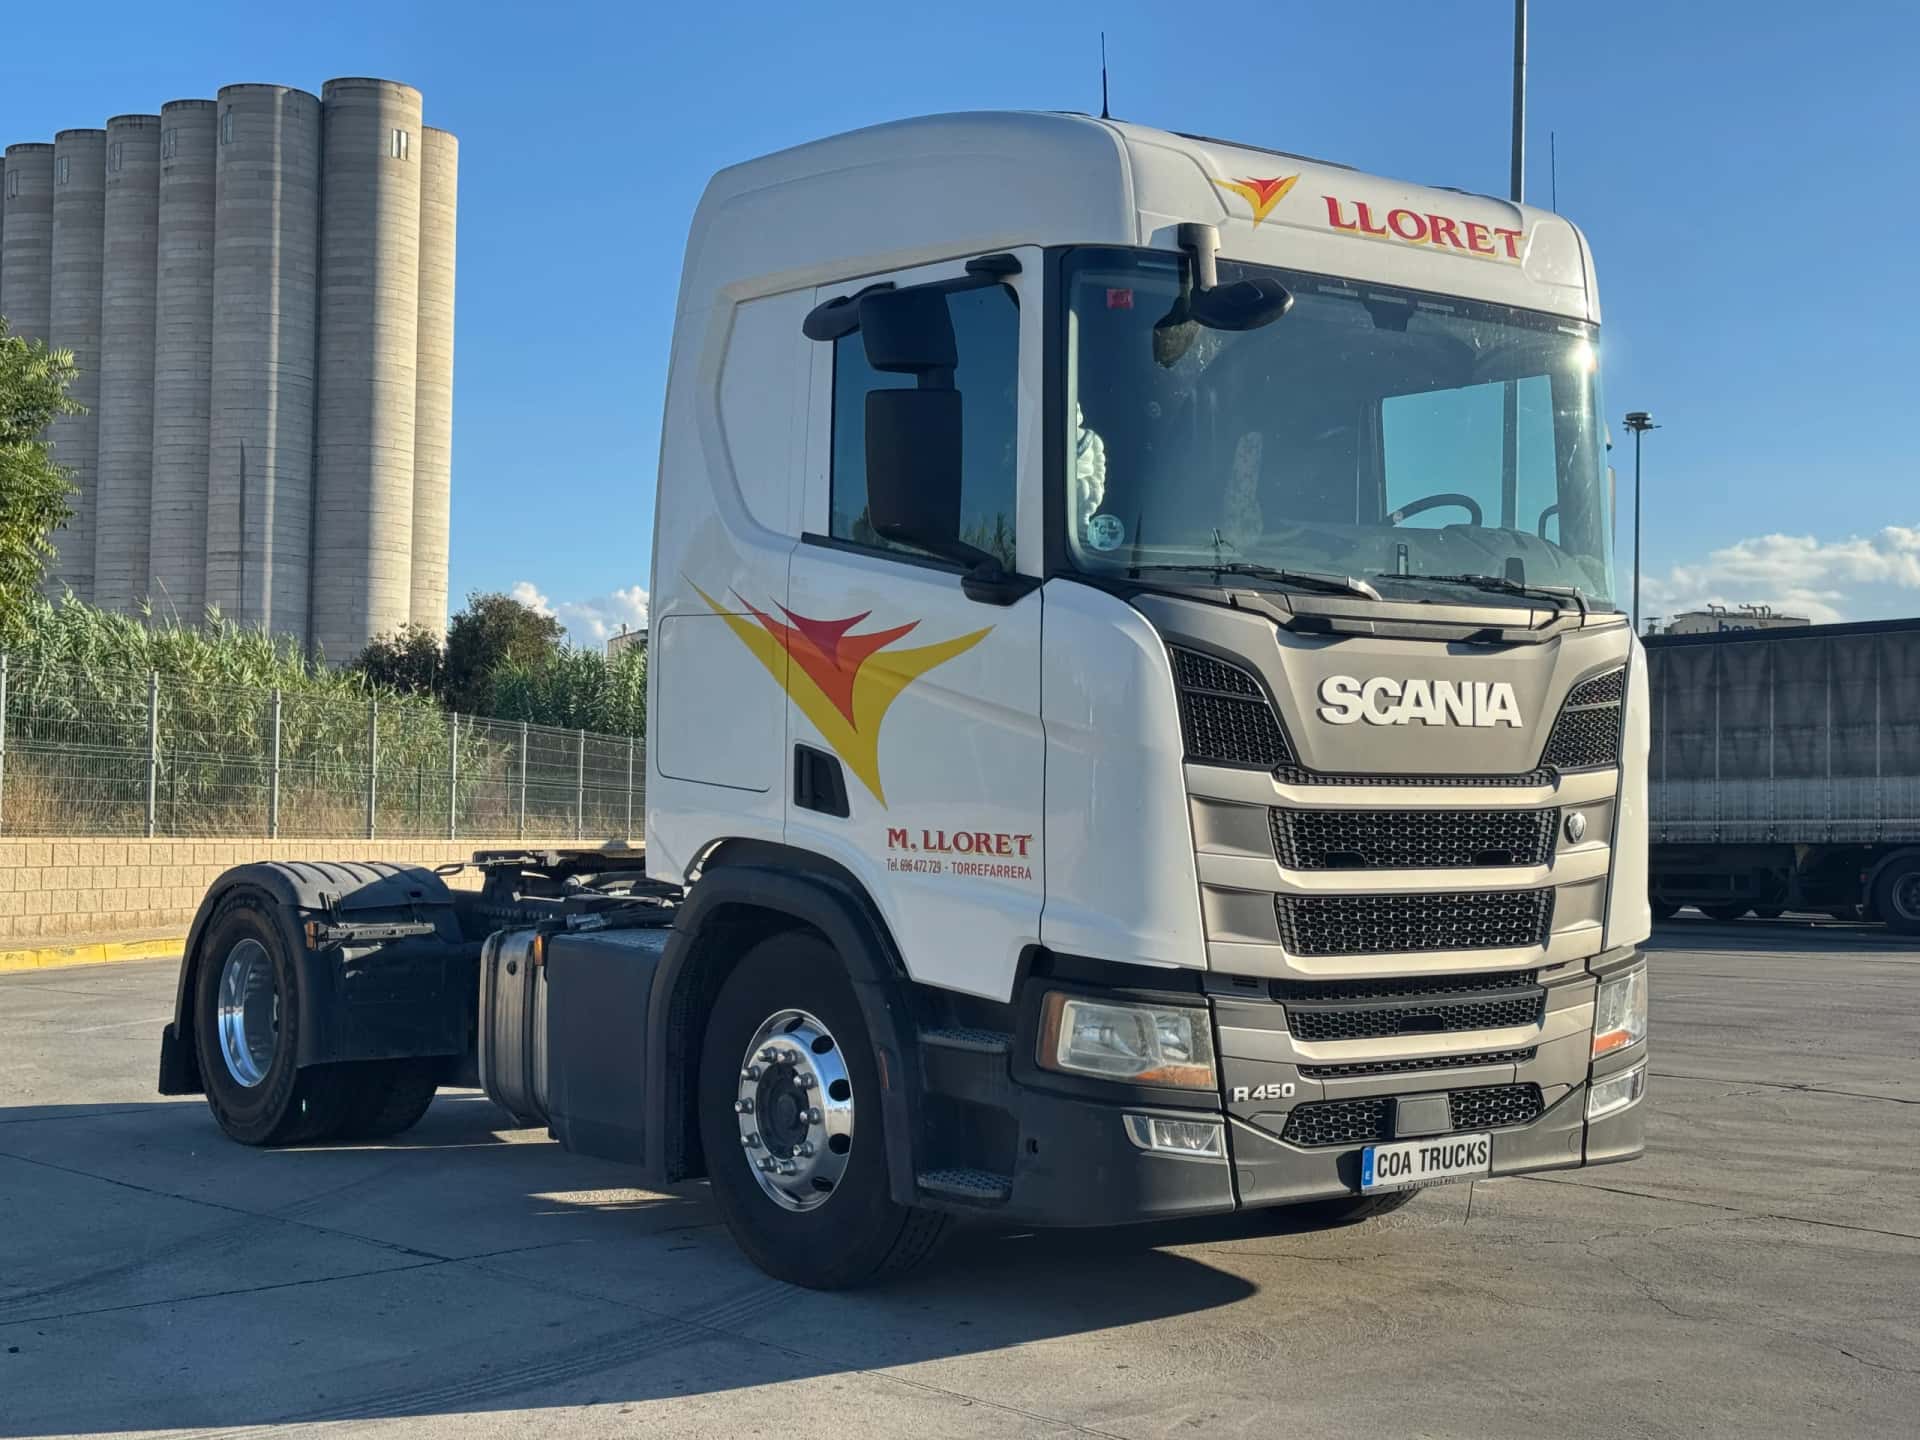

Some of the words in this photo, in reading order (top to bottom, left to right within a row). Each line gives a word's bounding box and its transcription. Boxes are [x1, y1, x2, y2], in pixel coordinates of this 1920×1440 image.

[1320, 195, 1523, 262] LLORET
[1316, 675, 1523, 728] SCANIA
[887, 828, 917, 850] M.
[921, 829, 1033, 857] LLORET
[887, 858, 899, 872] Tel.
[913, 860, 927, 873] 472
[928, 861, 942, 874] 729
[951, 862, 1033, 881] TORREFARRERA
[1233, 1086, 1249, 1102] R
[1251, 1083, 1296, 1100] 450
[1376, 1149, 1412, 1178] COA
[1418, 1140, 1488, 1172] TRUCKS
